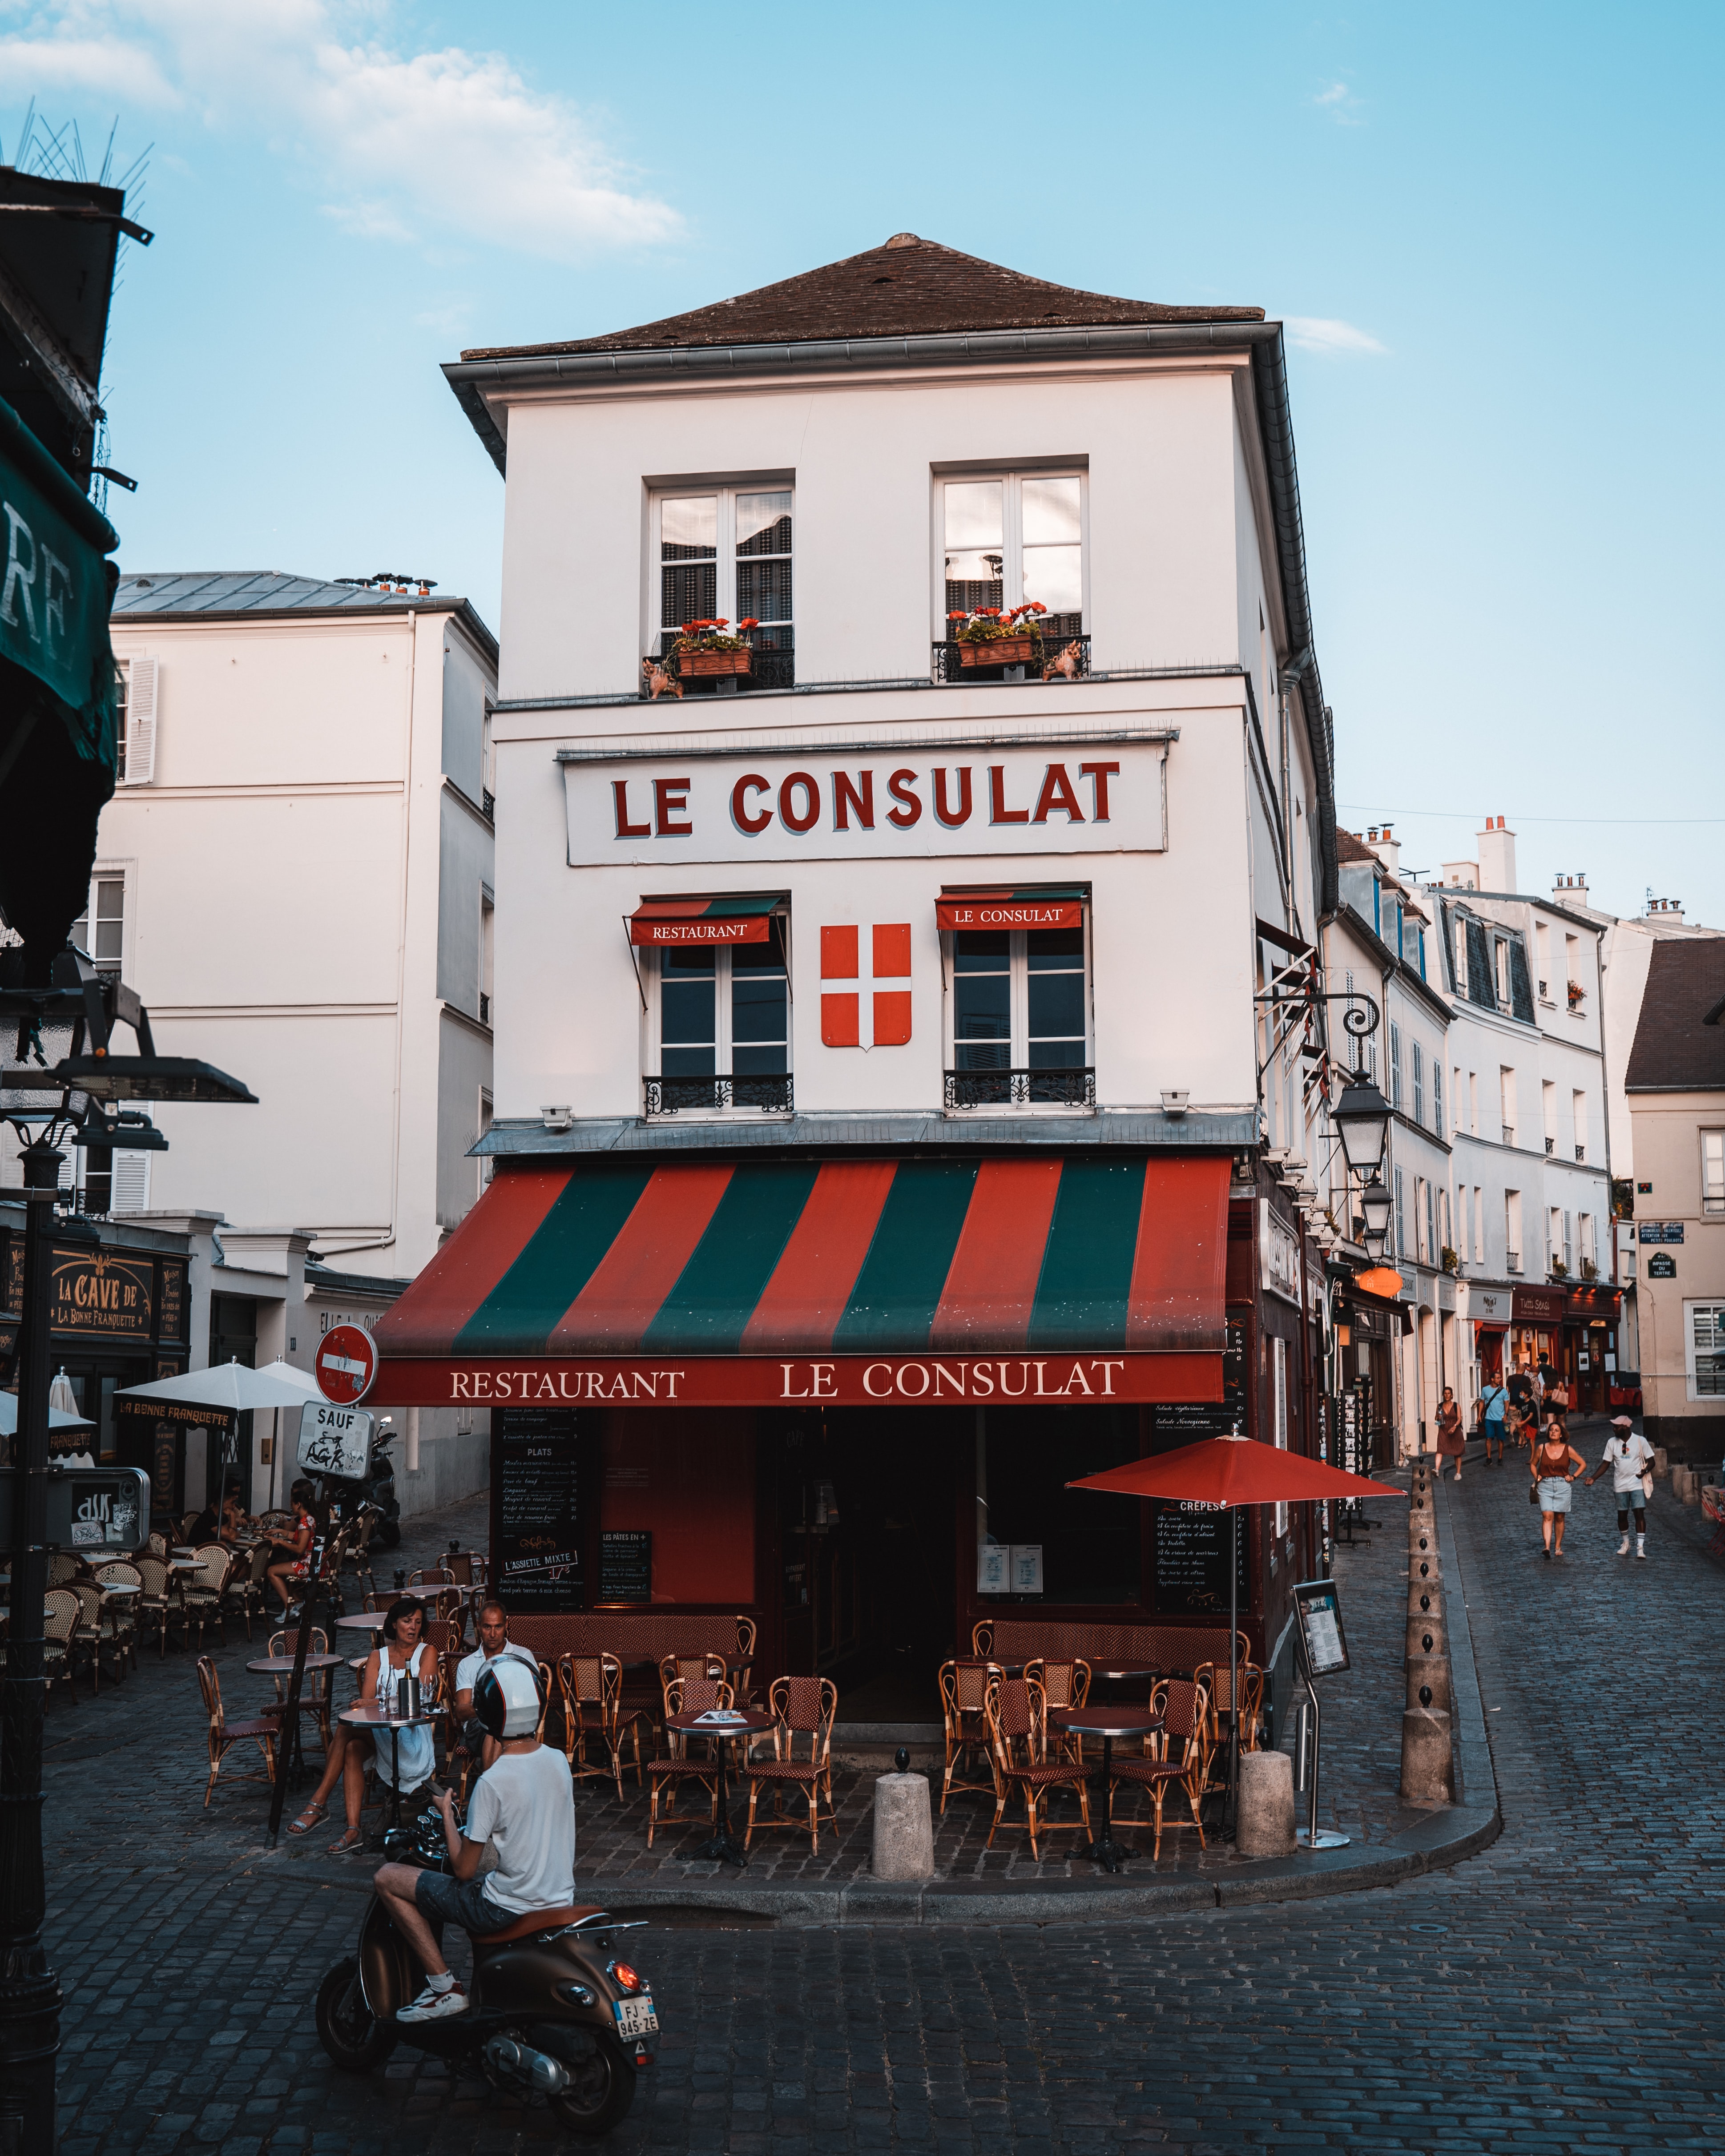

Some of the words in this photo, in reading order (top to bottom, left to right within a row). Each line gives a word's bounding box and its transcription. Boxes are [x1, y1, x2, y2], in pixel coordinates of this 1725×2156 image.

[611, 778, 693, 840] LE
[729, 762, 1120, 837] CONSULAT
[954, 911, 973, 923] LE
[980, 908, 1063, 922] CONSULAT
[653, 924, 748, 940] RESTAURANT
[163, 1270, 180, 1284] Maison
[59, 1278, 71, 1301] LA
[74, 1274, 120, 1310] CAVE
[123, 1285, 137, 1307] DE
[166, 1302, 175, 1310] 1925
[1520, 1295, 1534, 1309] Tutti
[1535, 1297, 1550, 1310] Sensi
[57, 1306, 69, 1324] LA
[70, 1308, 92, 1324] BONNE
[93, 1310, 136, 1330] FRANQUETTE
[450, 1372, 685, 1398] RESTAURANT
[779, 1361, 838, 1400] LE
[860, 1358, 1126, 1398] CONSULAT
[121, 1402, 132, 1414] LA
[133, 1403, 165, 1417] BONNE
[168, 1407, 229, 1427] FRANQUETTE
[318, 1409, 355, 1430] SAUF
[50, 1433, 91, 1449] FRANQUETTE
[1171, 1523, 1191, 1531] confiture
[1201, 1523, 1214, 1531] fraise
[1172, 1531, 1192, 1539] confiture
[505, 1557, 541, 1571] L'ASSIETTE
[544, 1553, 571, 1564] MIXTE
[512, 1587, 521, 1595] pork
[441, 1995, 451, 2004] FILA
